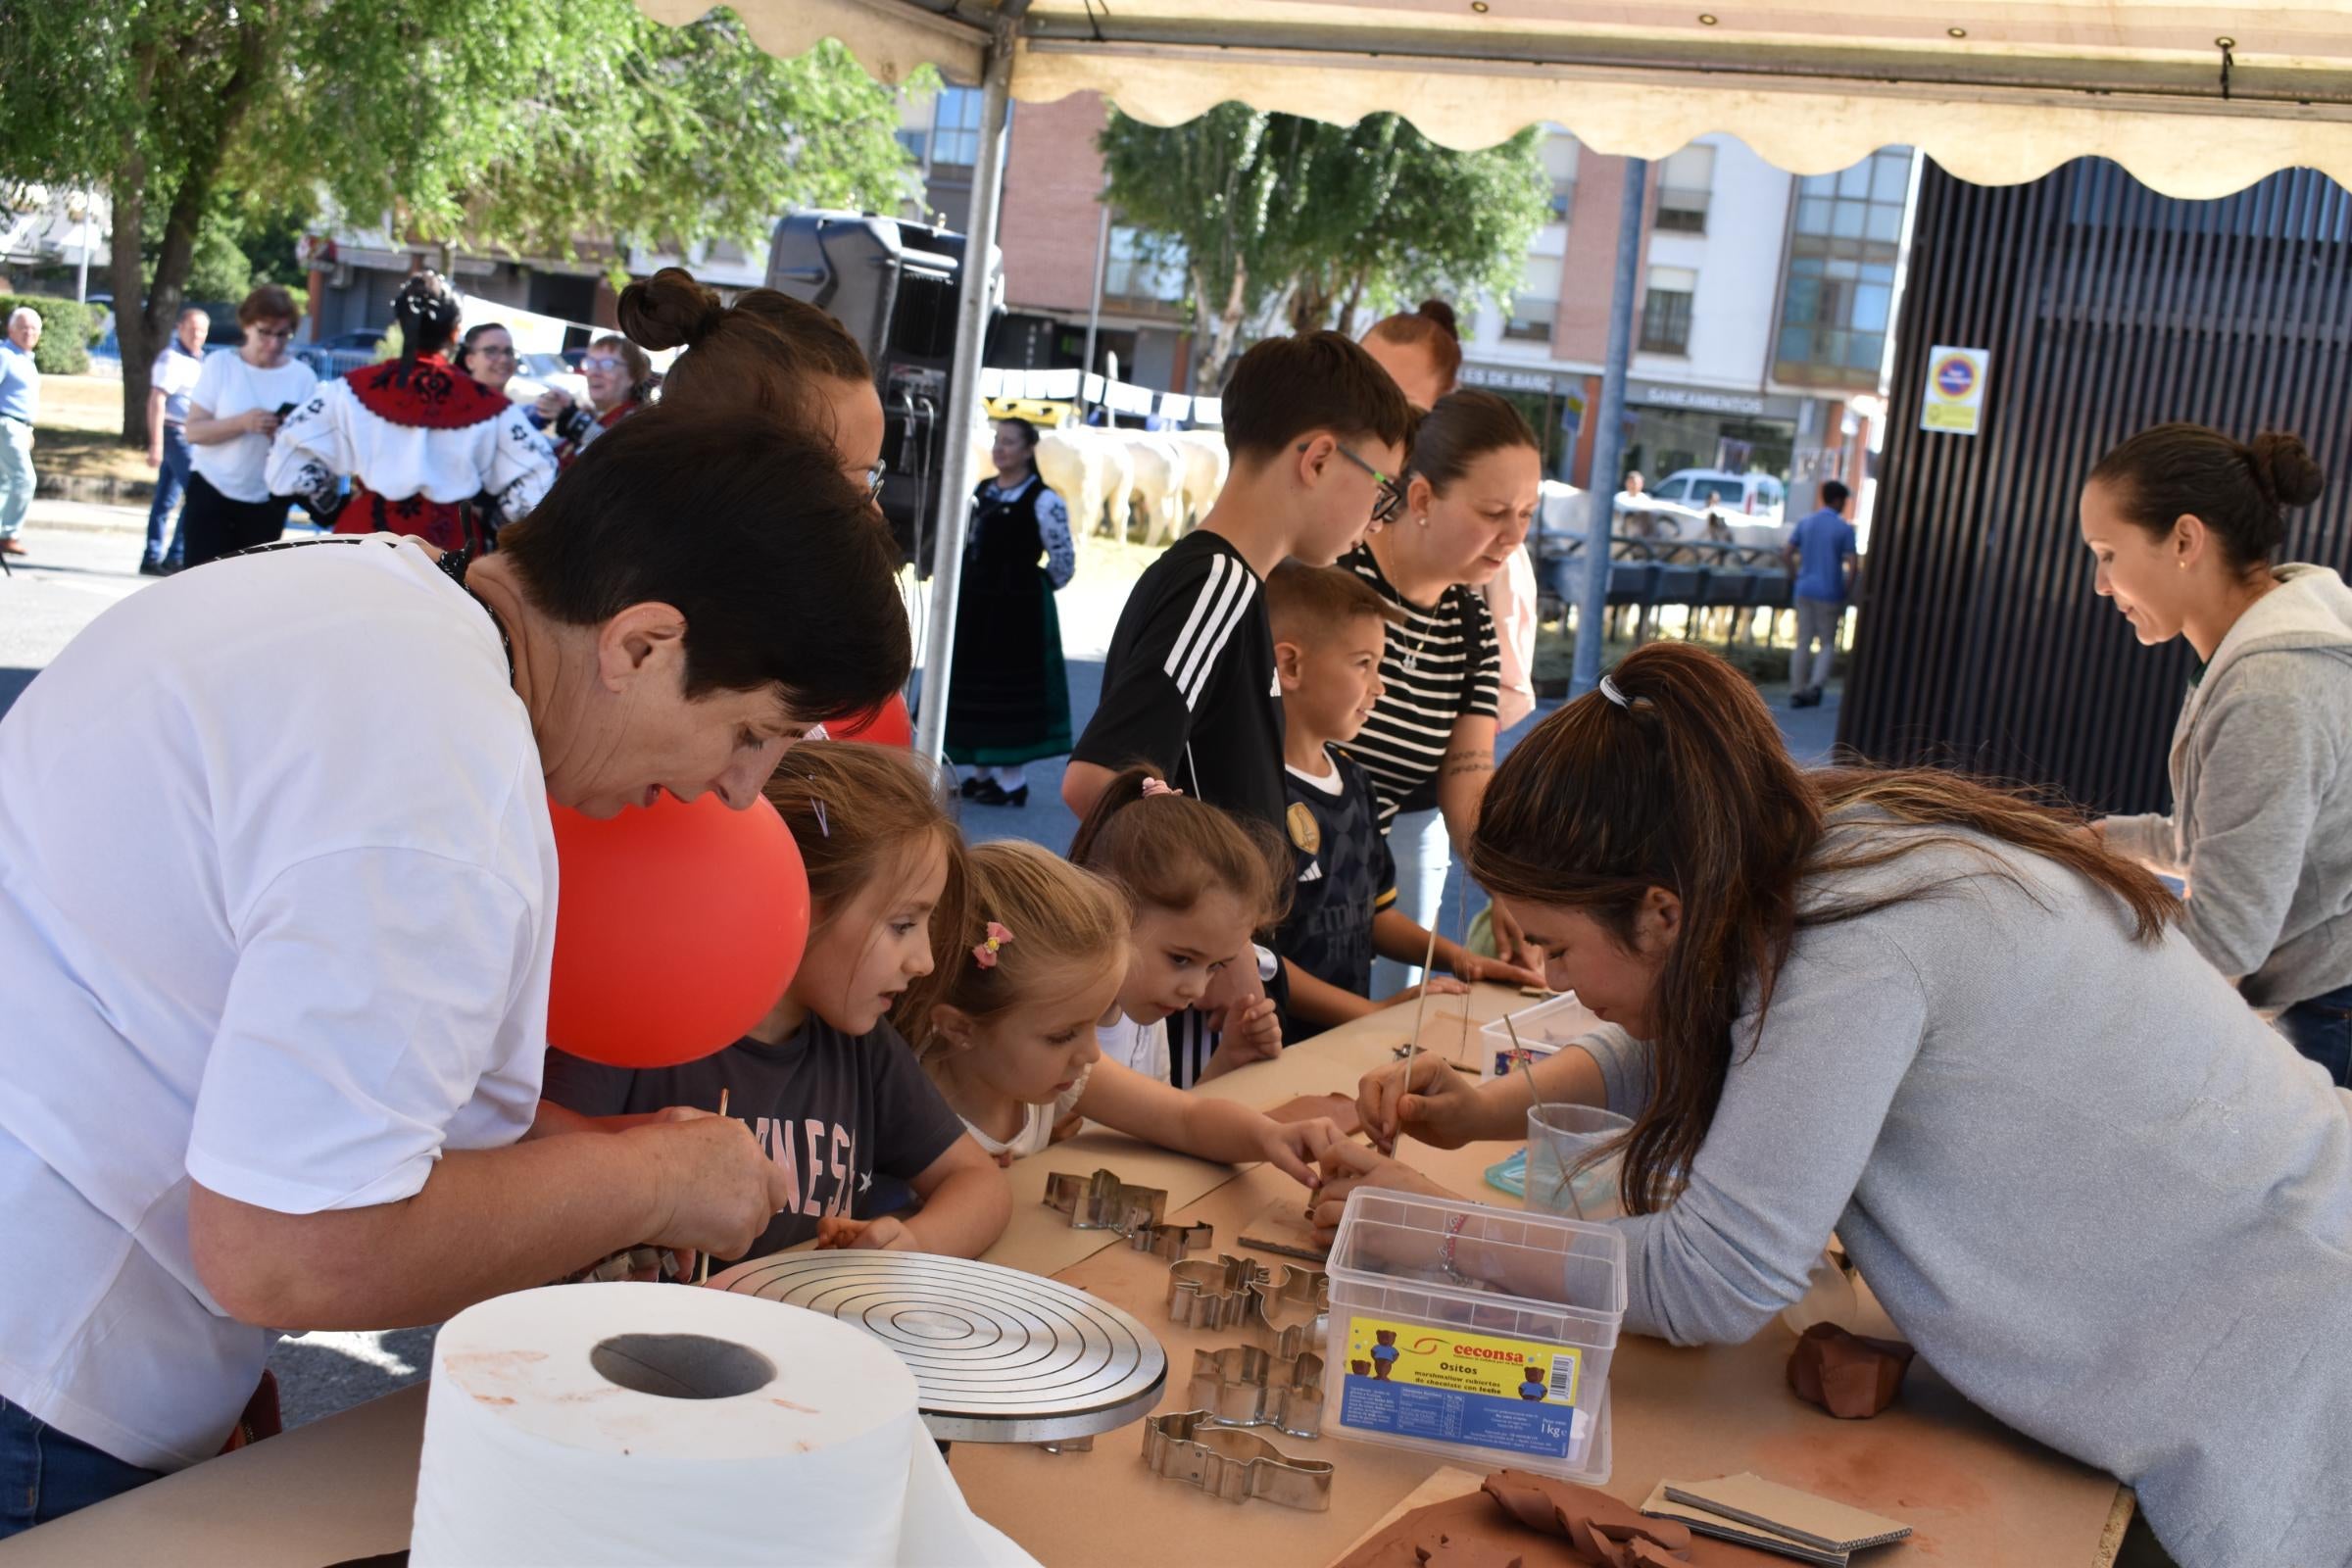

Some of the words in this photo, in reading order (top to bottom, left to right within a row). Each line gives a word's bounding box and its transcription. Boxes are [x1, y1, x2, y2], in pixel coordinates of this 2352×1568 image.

[1646, 387, 1762, 415] SANEAMIENTOS
[1453, 1345, 1524, 1363] ceconsa
[1440, 1362, 1478, 1375] Ositos
[1414, 1371, 1463, 1383] marshmallow
[1426, 1379, 1461, 1389] chocolate
[1479, 1384, 1501, 1395] leche
